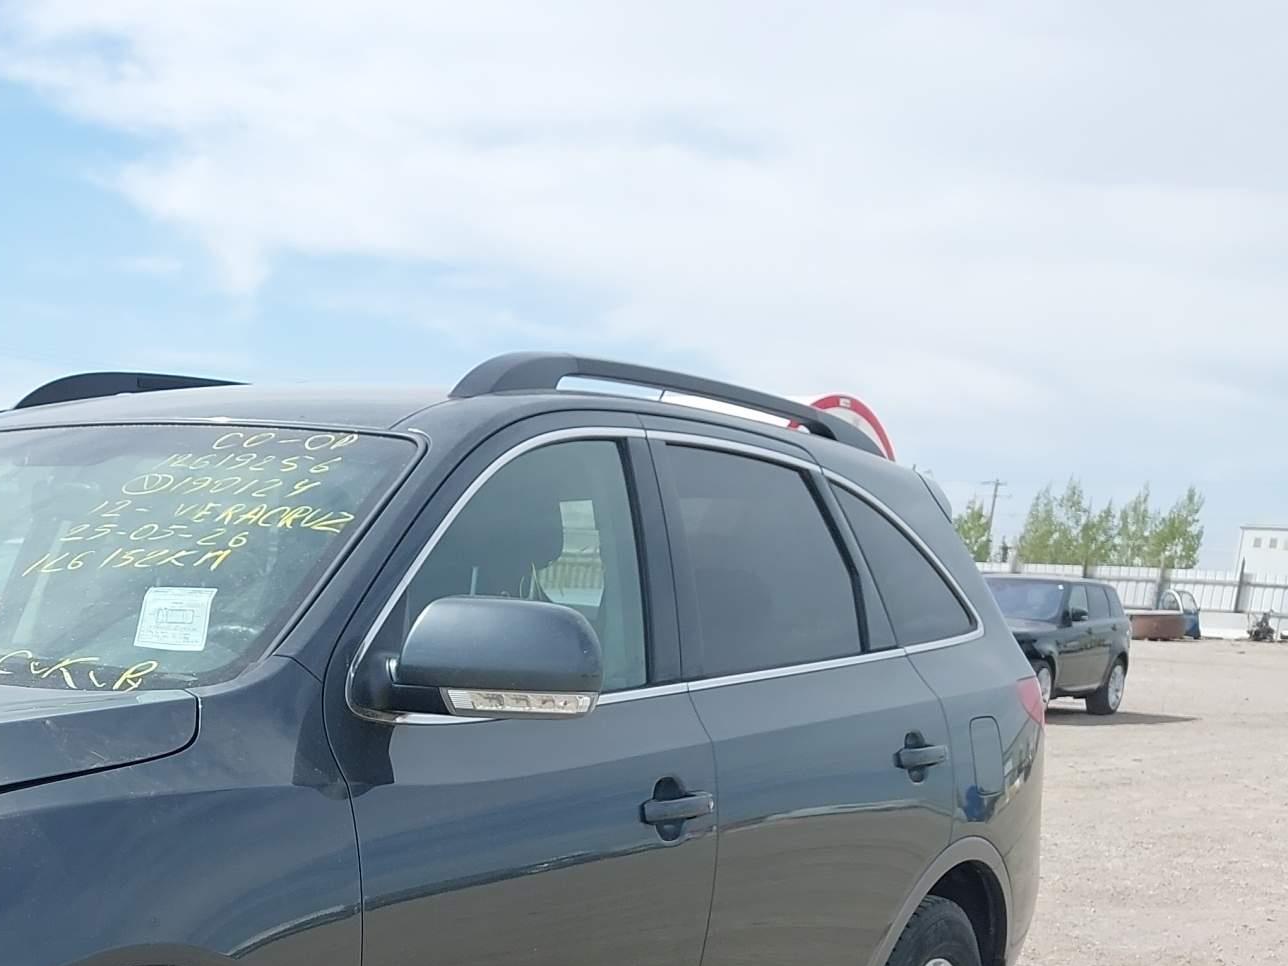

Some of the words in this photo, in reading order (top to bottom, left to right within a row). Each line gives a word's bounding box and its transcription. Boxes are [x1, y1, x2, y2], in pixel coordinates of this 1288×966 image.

[152, 453, 343, 474] 12619256
[174, 503, 355, 533] VERACRUZ
[59, 523, 249, 548] 25-05-26
